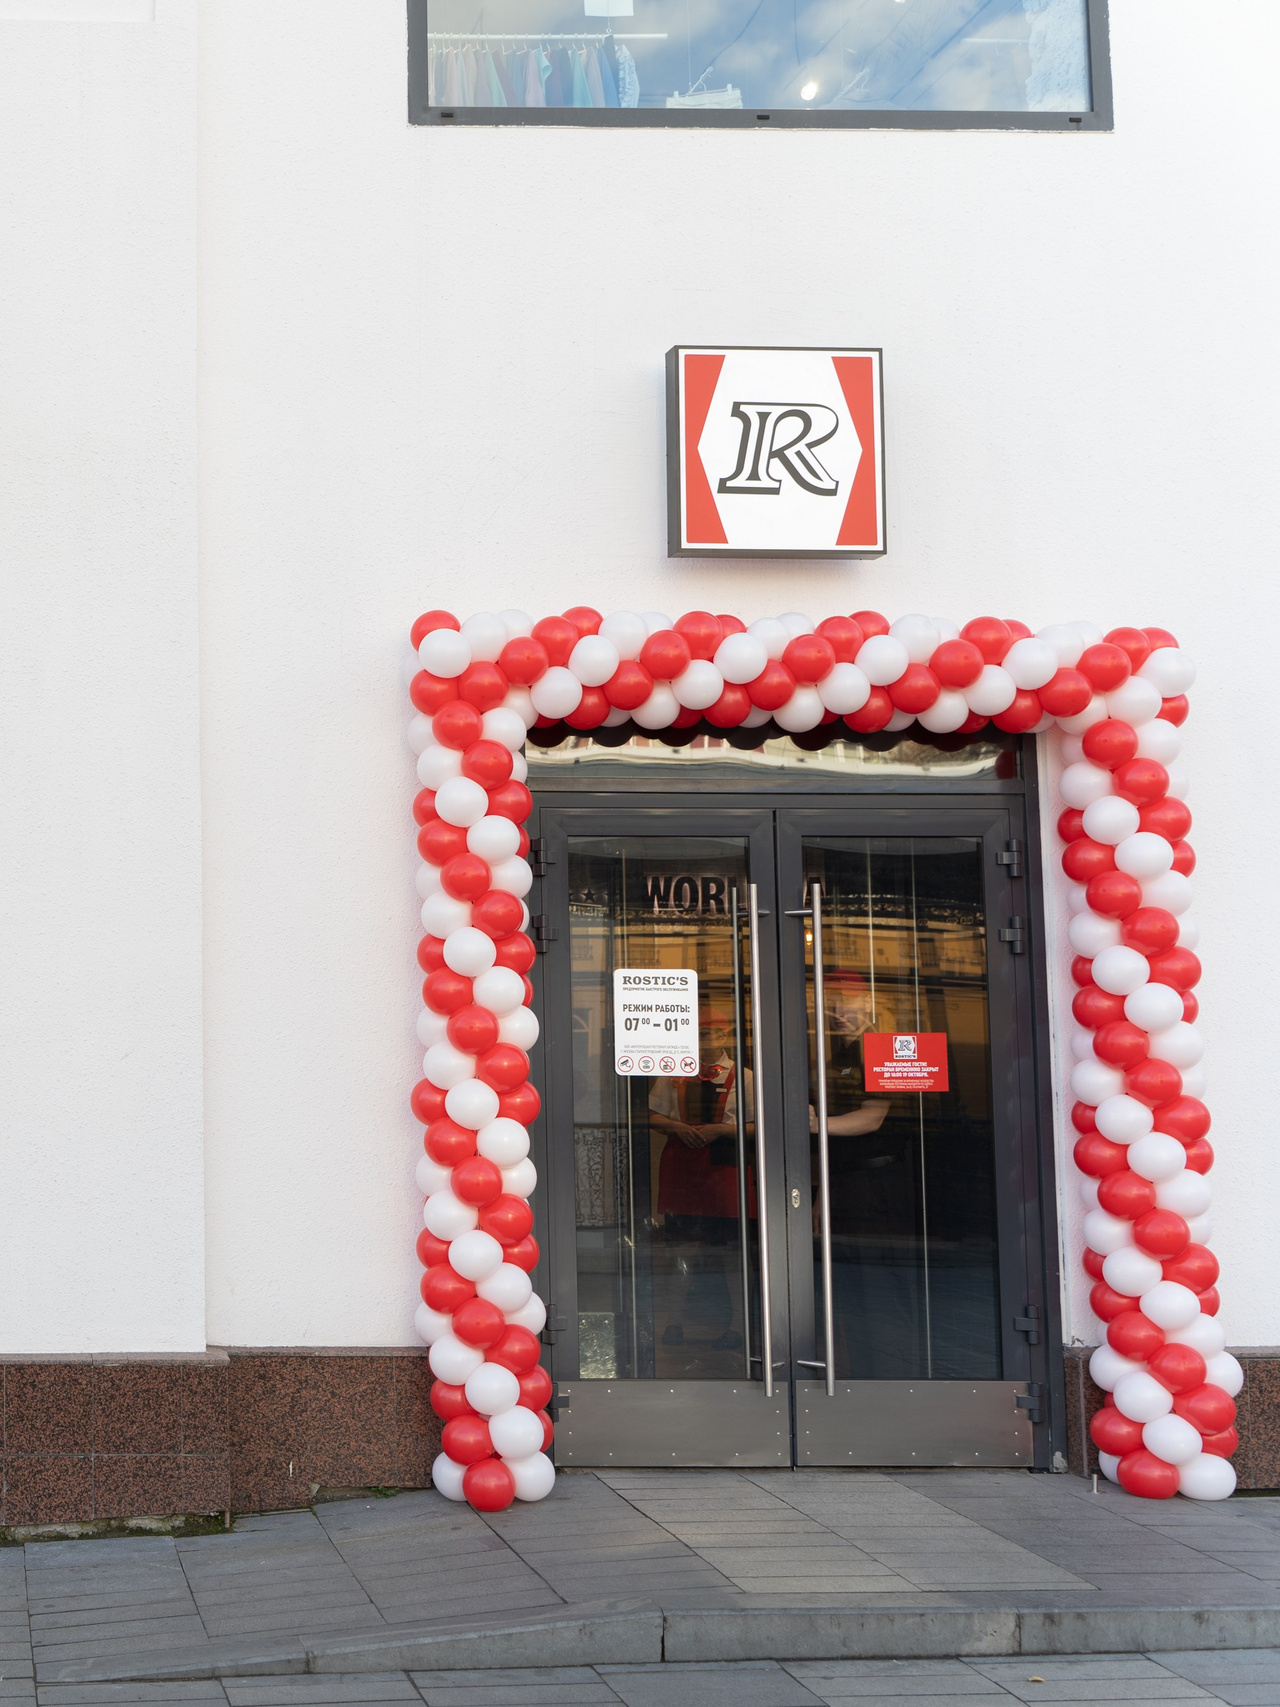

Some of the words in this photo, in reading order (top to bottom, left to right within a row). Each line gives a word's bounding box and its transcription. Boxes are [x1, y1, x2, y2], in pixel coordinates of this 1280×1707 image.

[717, 401, 839, 497] R
[622, 976, 689, 986] ROSTIC'S
[622, 1004, 653, 1013] РЕЖИМ
[655, 1004, 691, 1013] РАБОТЫ:
